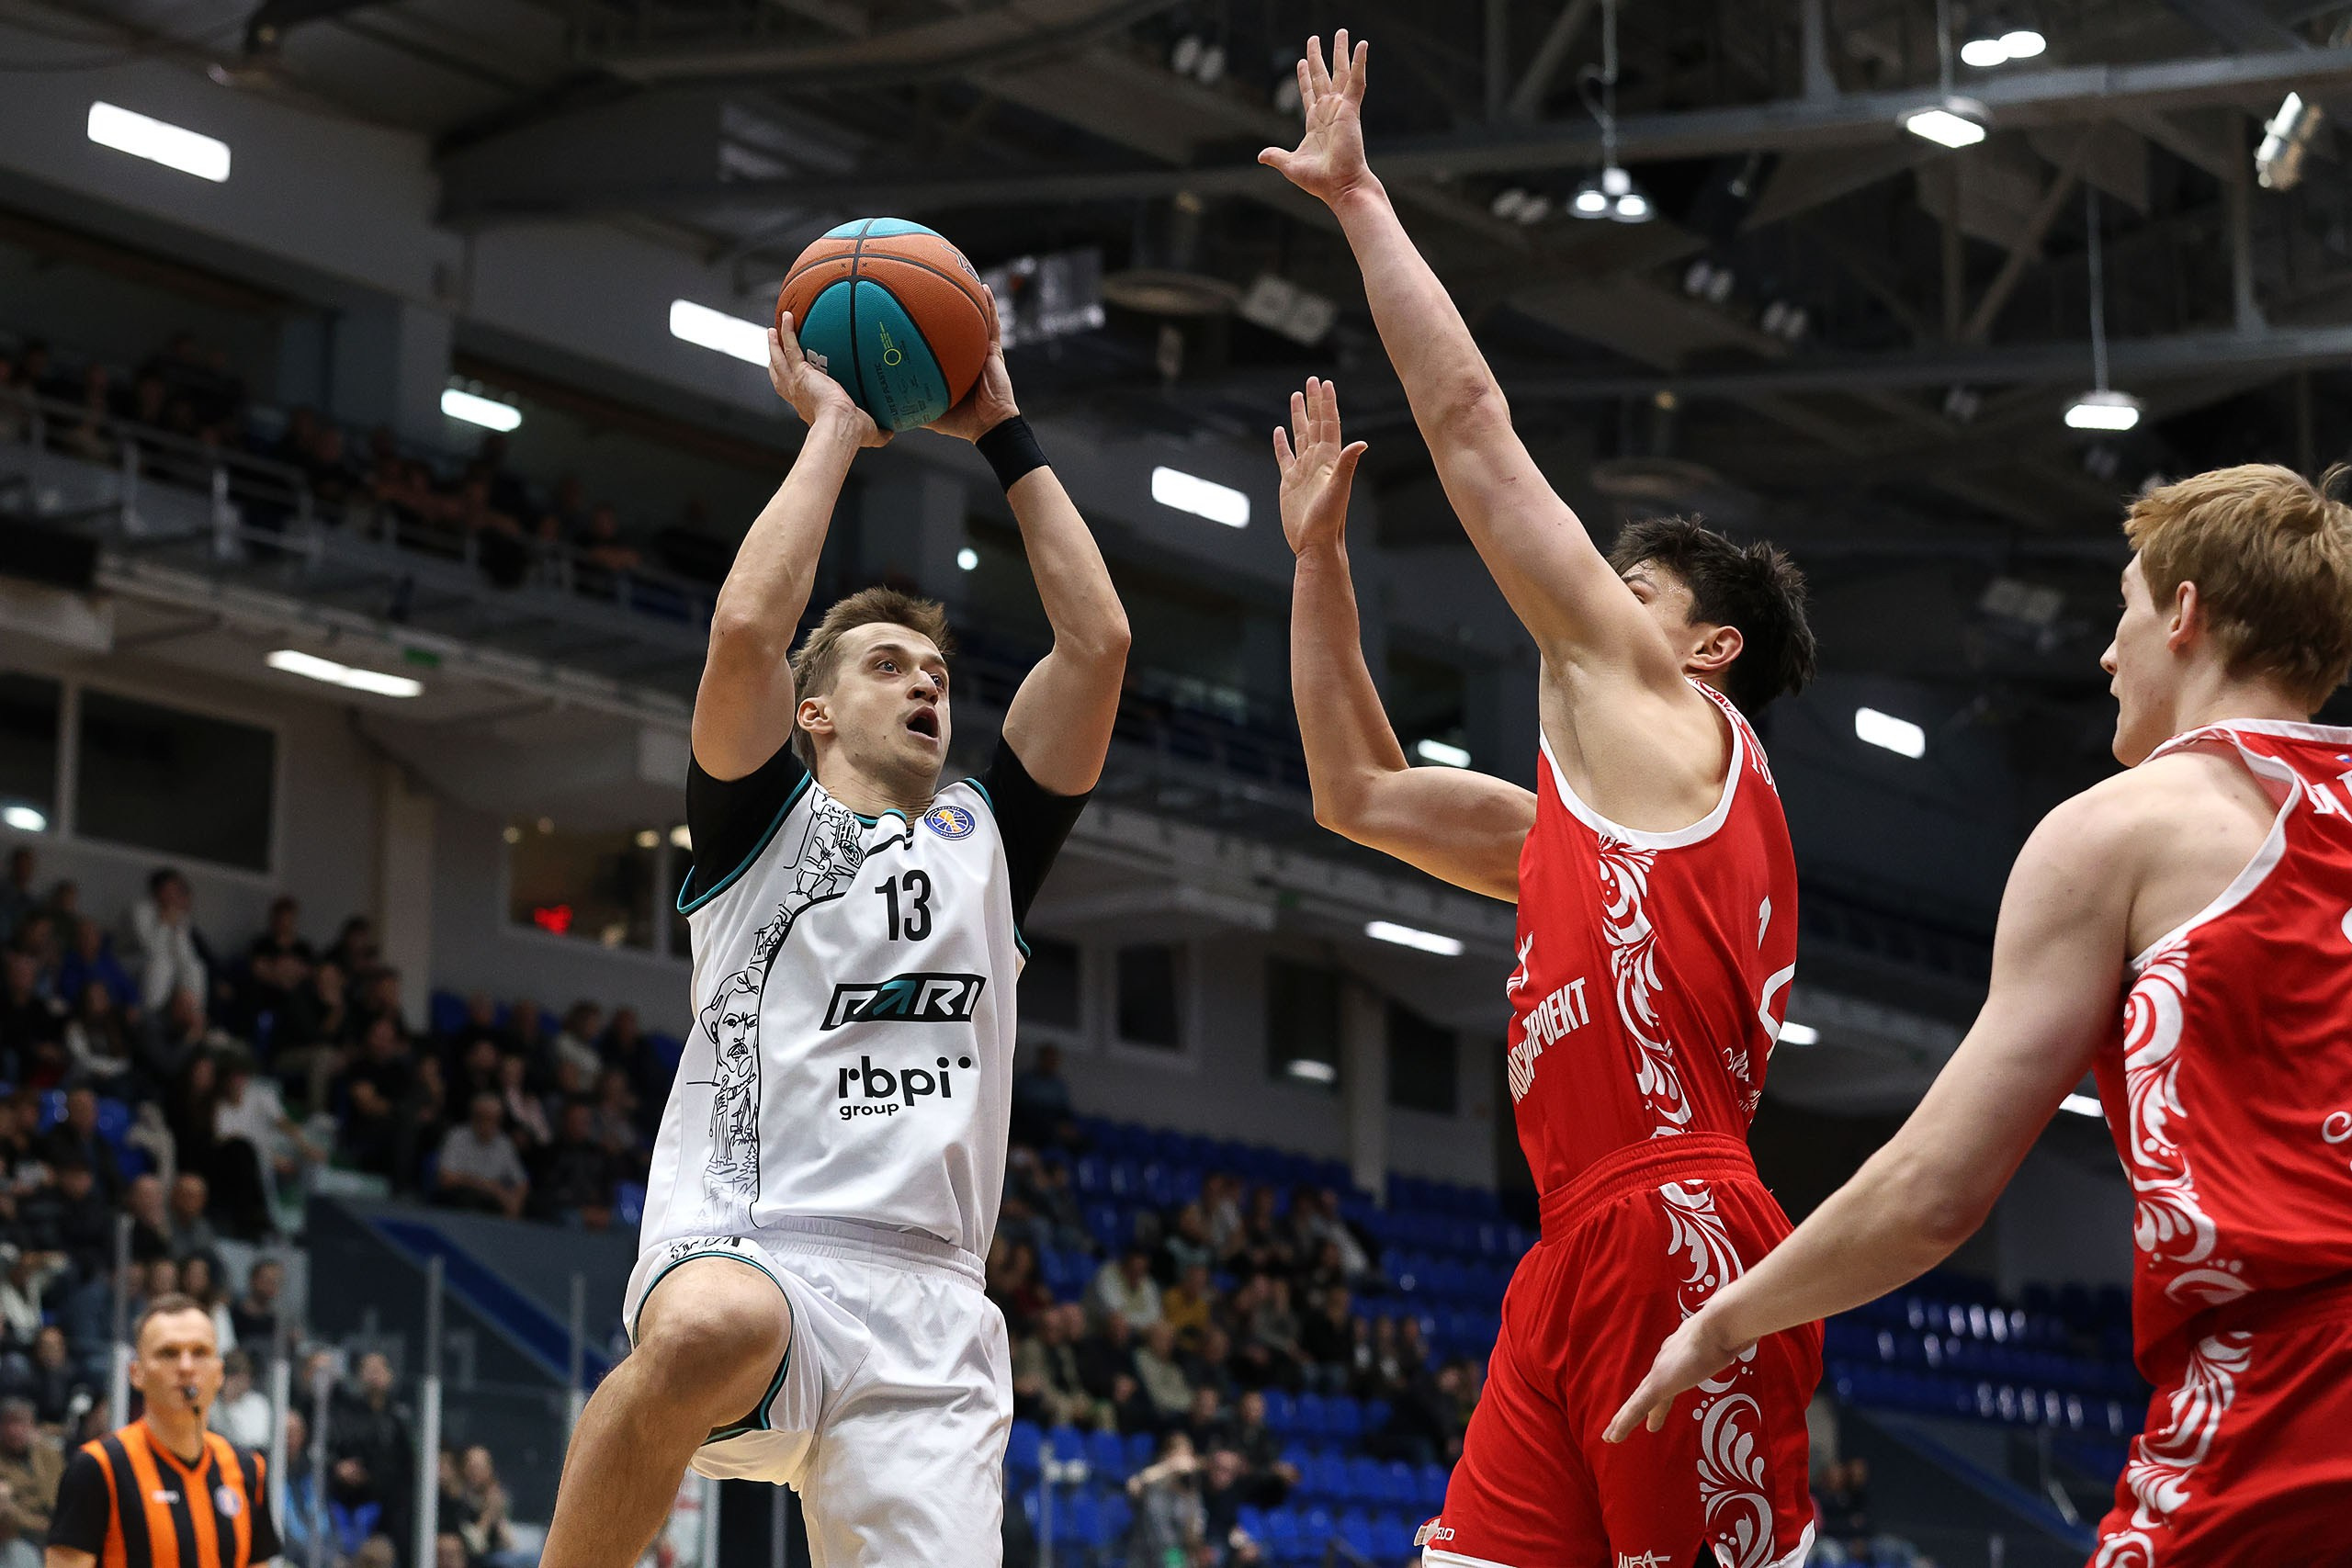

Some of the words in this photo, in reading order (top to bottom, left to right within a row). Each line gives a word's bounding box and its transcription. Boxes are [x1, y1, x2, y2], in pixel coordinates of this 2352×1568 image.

[875, 869, 932, 942] 13
[831, 979, 979, 1026] PARI
[839, 1103, 899, 1121] group
